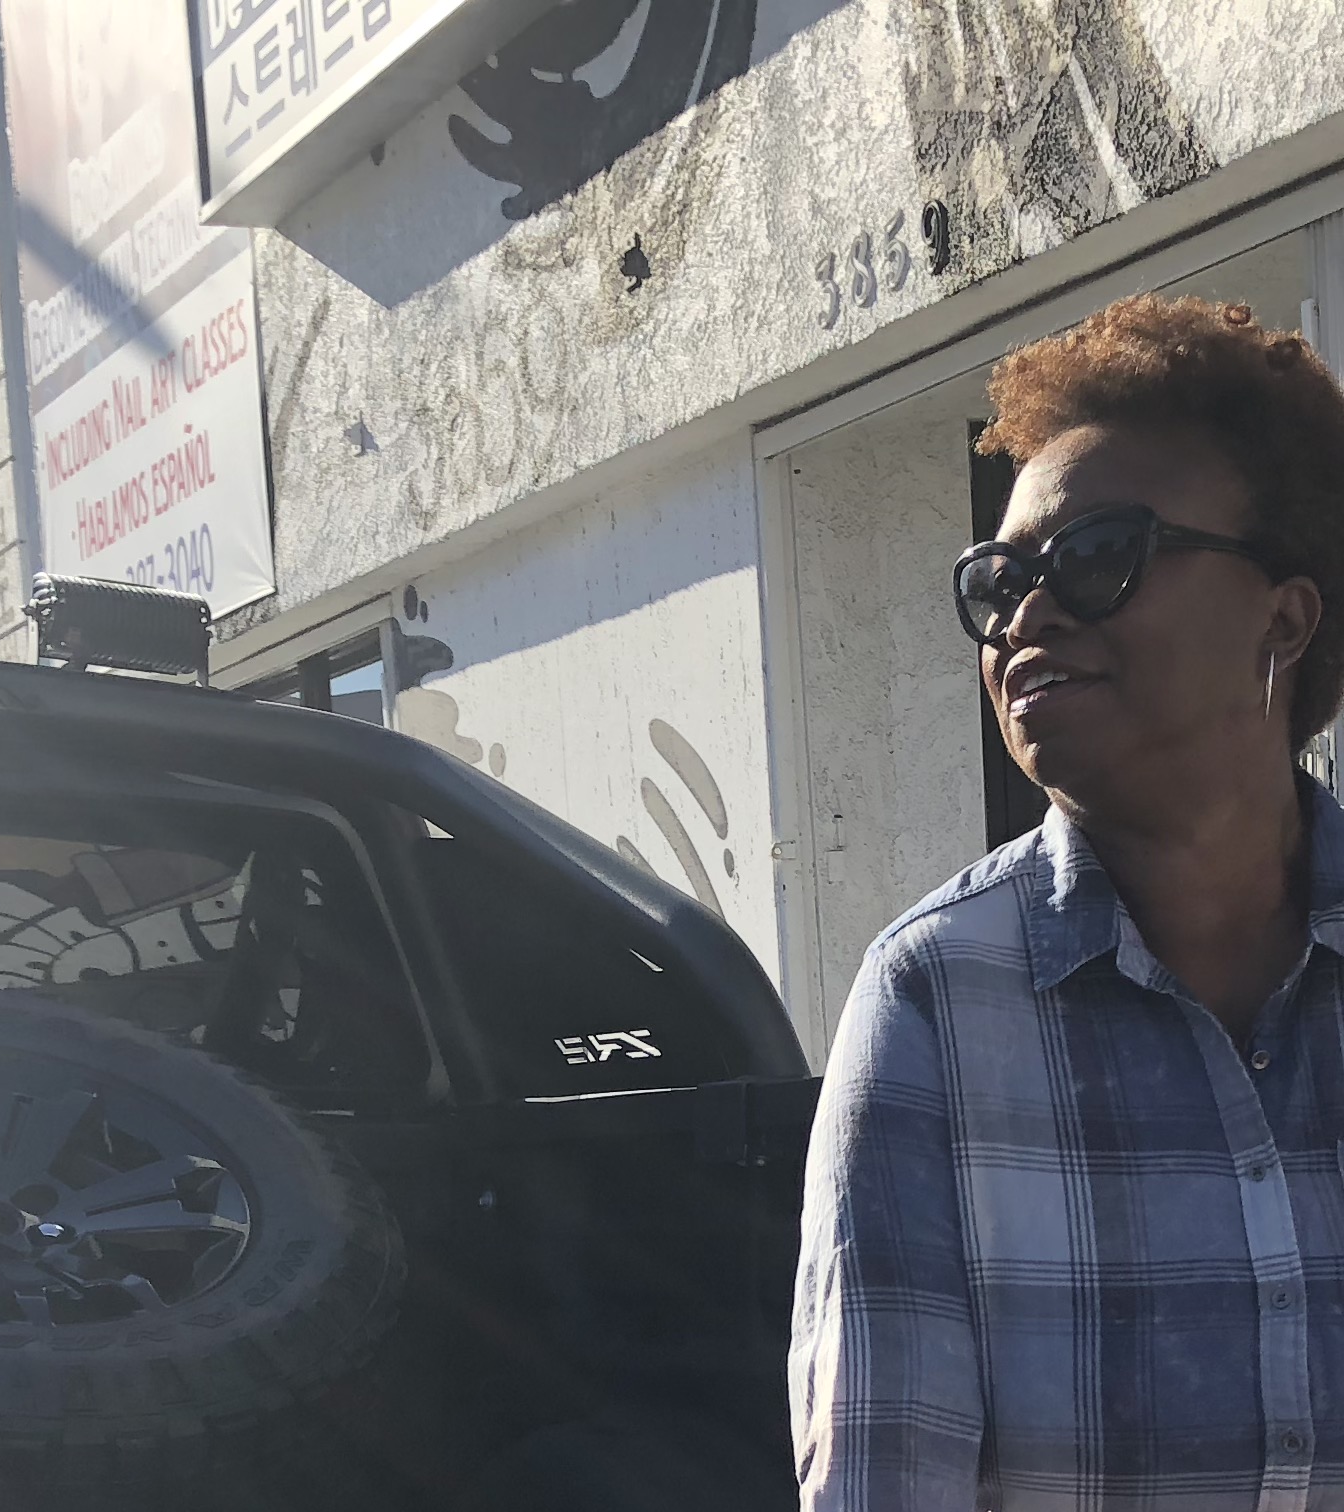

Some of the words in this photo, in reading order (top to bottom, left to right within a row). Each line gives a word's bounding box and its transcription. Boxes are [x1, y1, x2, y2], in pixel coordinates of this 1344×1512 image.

[44, 398, 111, 490] INCLUDING
[111, 376, 147, 444] NAIL
[150, 350, 177, 418] ART
[181, 298, 248, 394] CLASSES
[75, 470, 150, 561] HABLAMOS
[150, 422, 216, 517] ESPAÑOL
